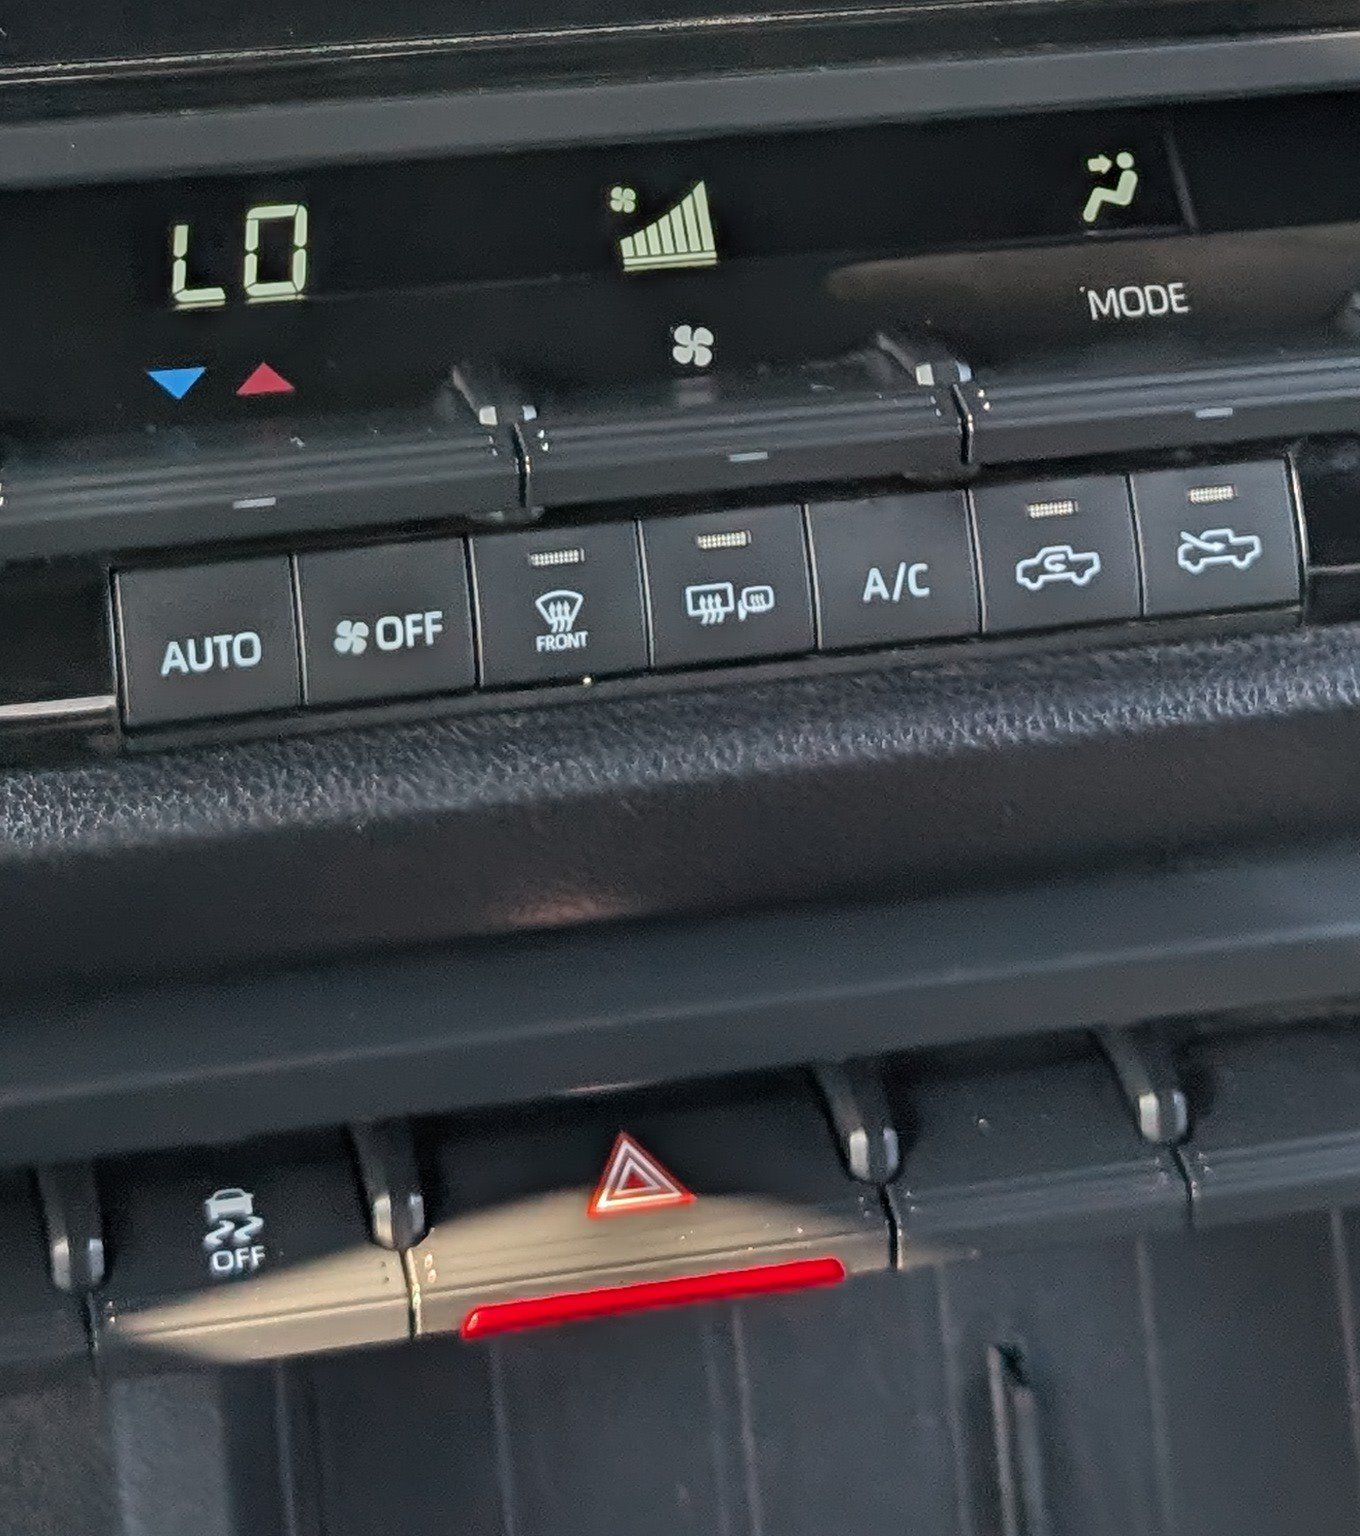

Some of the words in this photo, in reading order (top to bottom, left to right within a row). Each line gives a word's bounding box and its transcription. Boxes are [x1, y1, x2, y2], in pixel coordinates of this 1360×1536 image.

[1086, 282, 1190, 321] MODE
[861, 558, 931, 606] A/C
[375, 609, 444, 652] OFF
[535, 630, 589, 652] FRONT
[160, 630, 262, 679] AUTO
[210, 1244, 267, 1273] OFF
